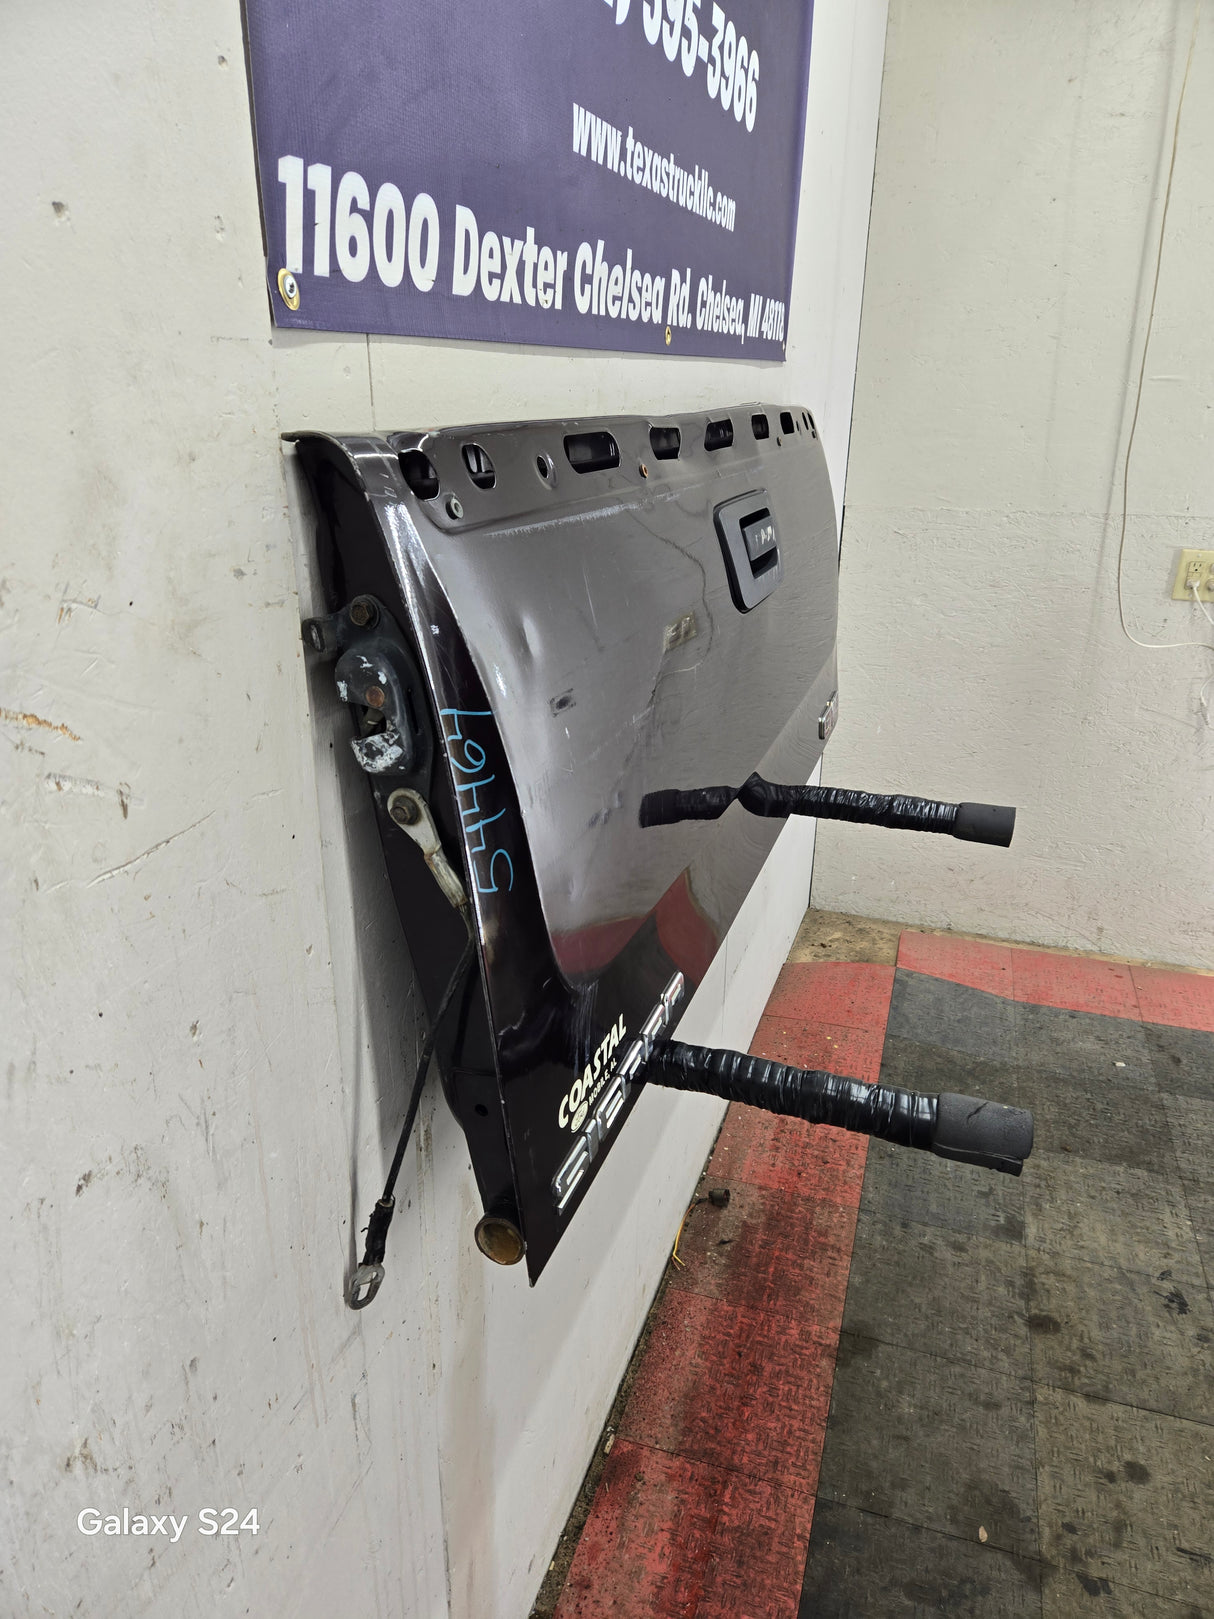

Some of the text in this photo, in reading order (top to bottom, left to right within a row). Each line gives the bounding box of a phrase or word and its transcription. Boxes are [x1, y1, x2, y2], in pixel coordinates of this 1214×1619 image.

[278, 154, 785, 345] 11600 Dexter Chelsea Rd. Chelsea, MI 48118
[573, 102, 737, 233] www.texastruckllc.com
[440, 708, 514, 893] 54464
[551, 970, 685, 1216] SIERRA
[558, 1013, 627, 1129] COASTAL
